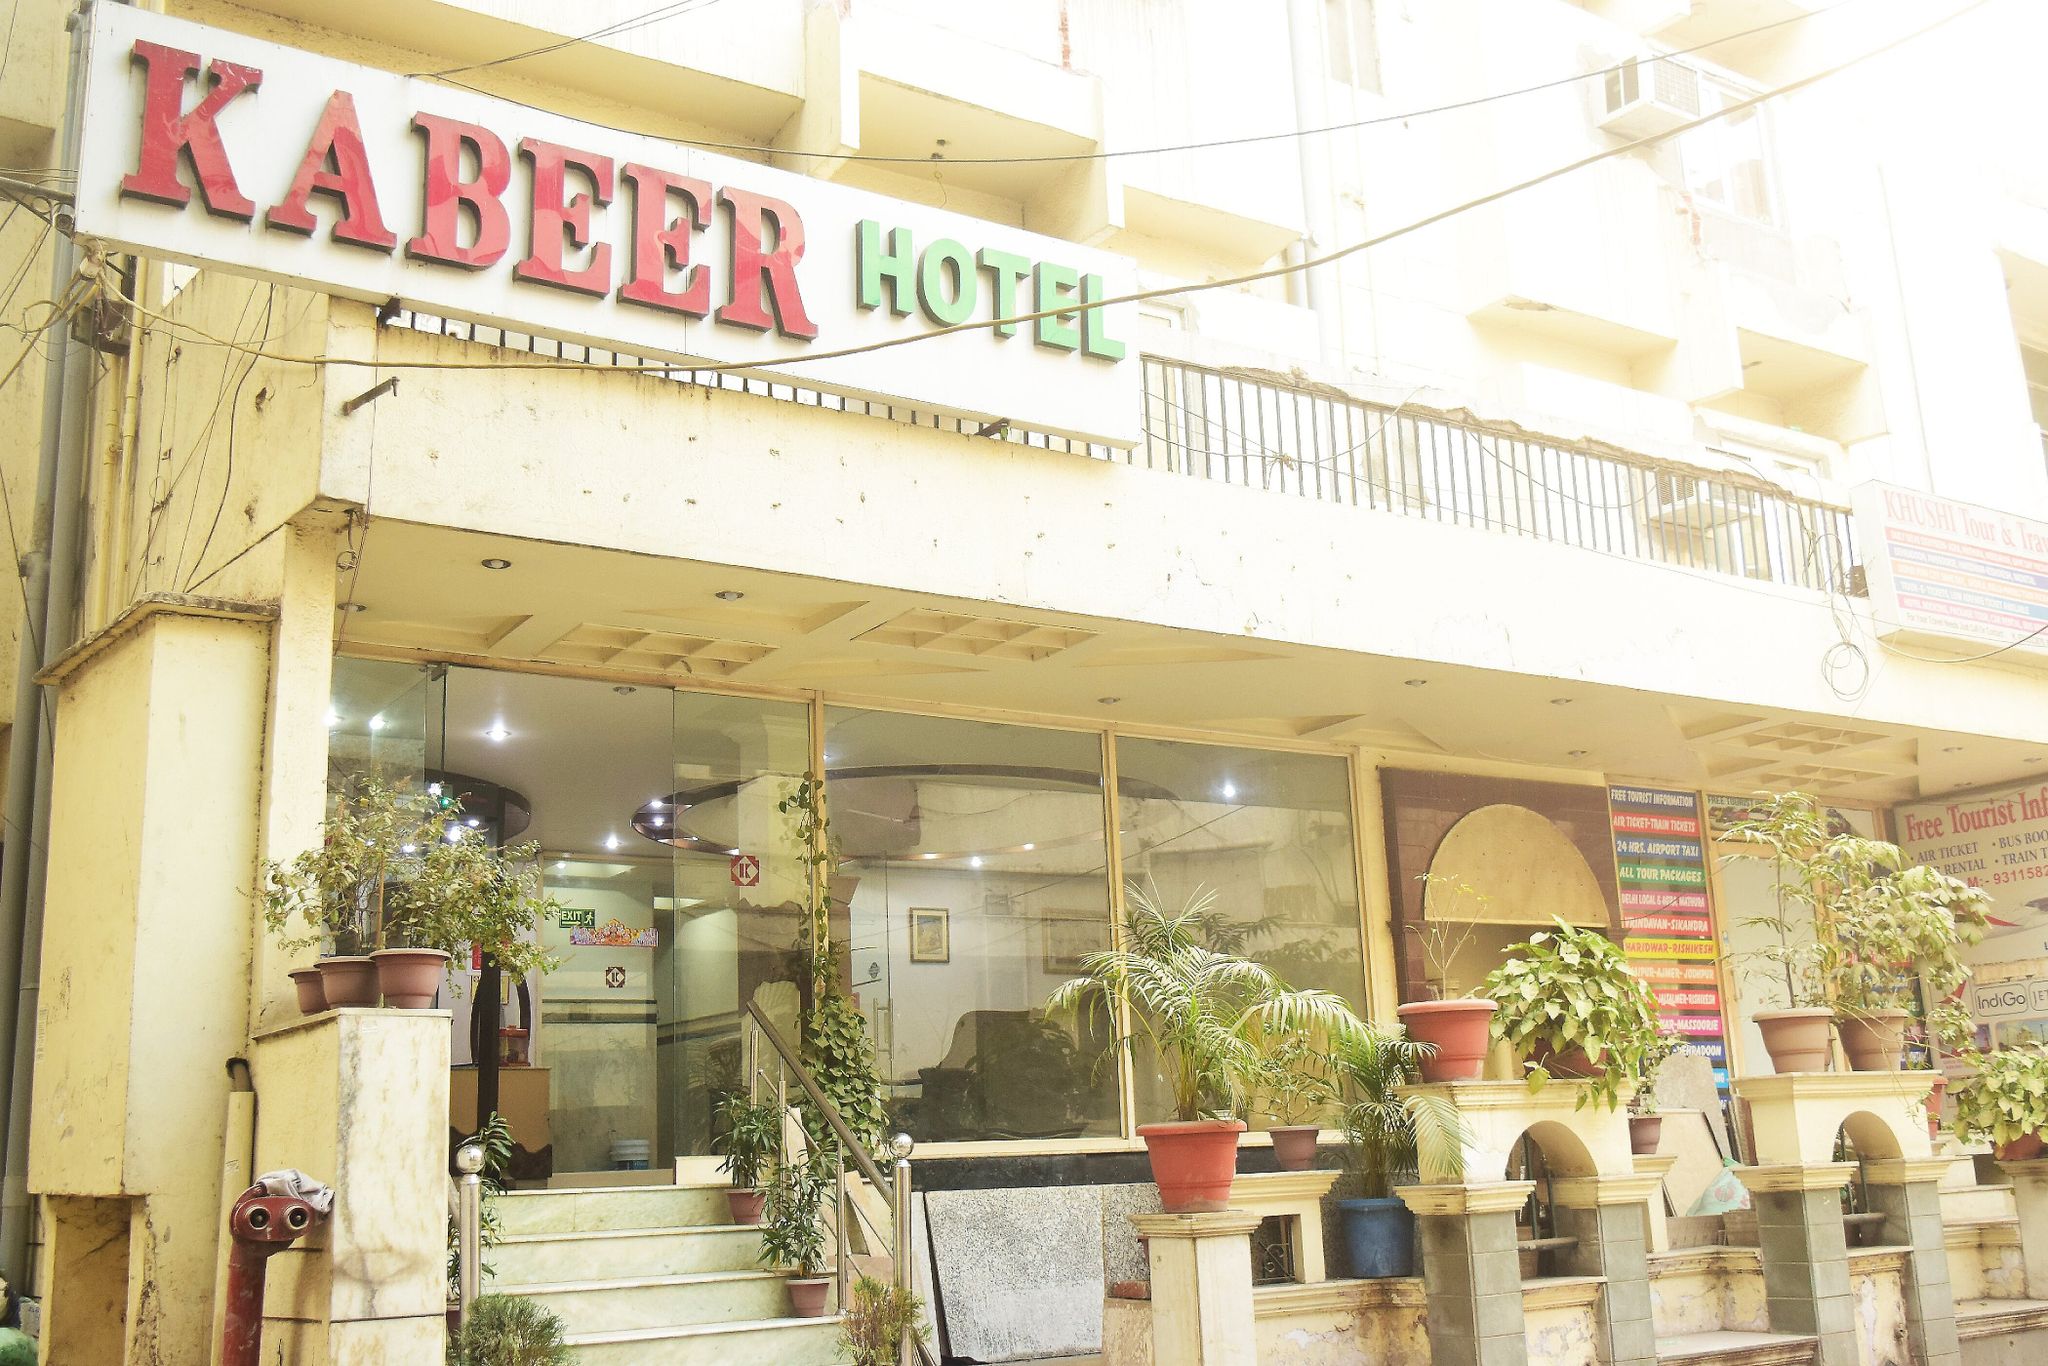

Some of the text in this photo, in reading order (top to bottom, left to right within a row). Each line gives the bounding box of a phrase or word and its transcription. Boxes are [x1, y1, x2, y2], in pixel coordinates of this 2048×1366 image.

[121, 39, 1126, 363] KABEER HOTEL
[1883, 489, 1957, 532] KHUSHI
[1958, 507, 1996, 541] Tour
[1611, 789, 1693, 807] FREE TOURIST INFORMATION
[1613, 816, 1696, 833] AIR TICKET-TRAIN TICKETS
[1904, 814, 1944, 842] Free
[1945, 798, 2017, 835] Tourist
[1617, 840, 1699, 857] 24 HRS. AIRPORT TAXI
[1917, 849, 1936, 863] AIR
[1939, 842, 1978, 858] TICKET
[1999, 834, 2022, 849] BUS
[1944, 858, 1987, 876] RENTAL
[2001, 849, 2038, 865] TRAIN
[1620, 866, 1634, 878] ALL
[1636, 867, 1659, 880] TOUR
[1639, 894, 1656, 906] LOCAL
[561, 911, 582, 921] EXIT
[1978, 991, 2026, 1010] IndiGo
